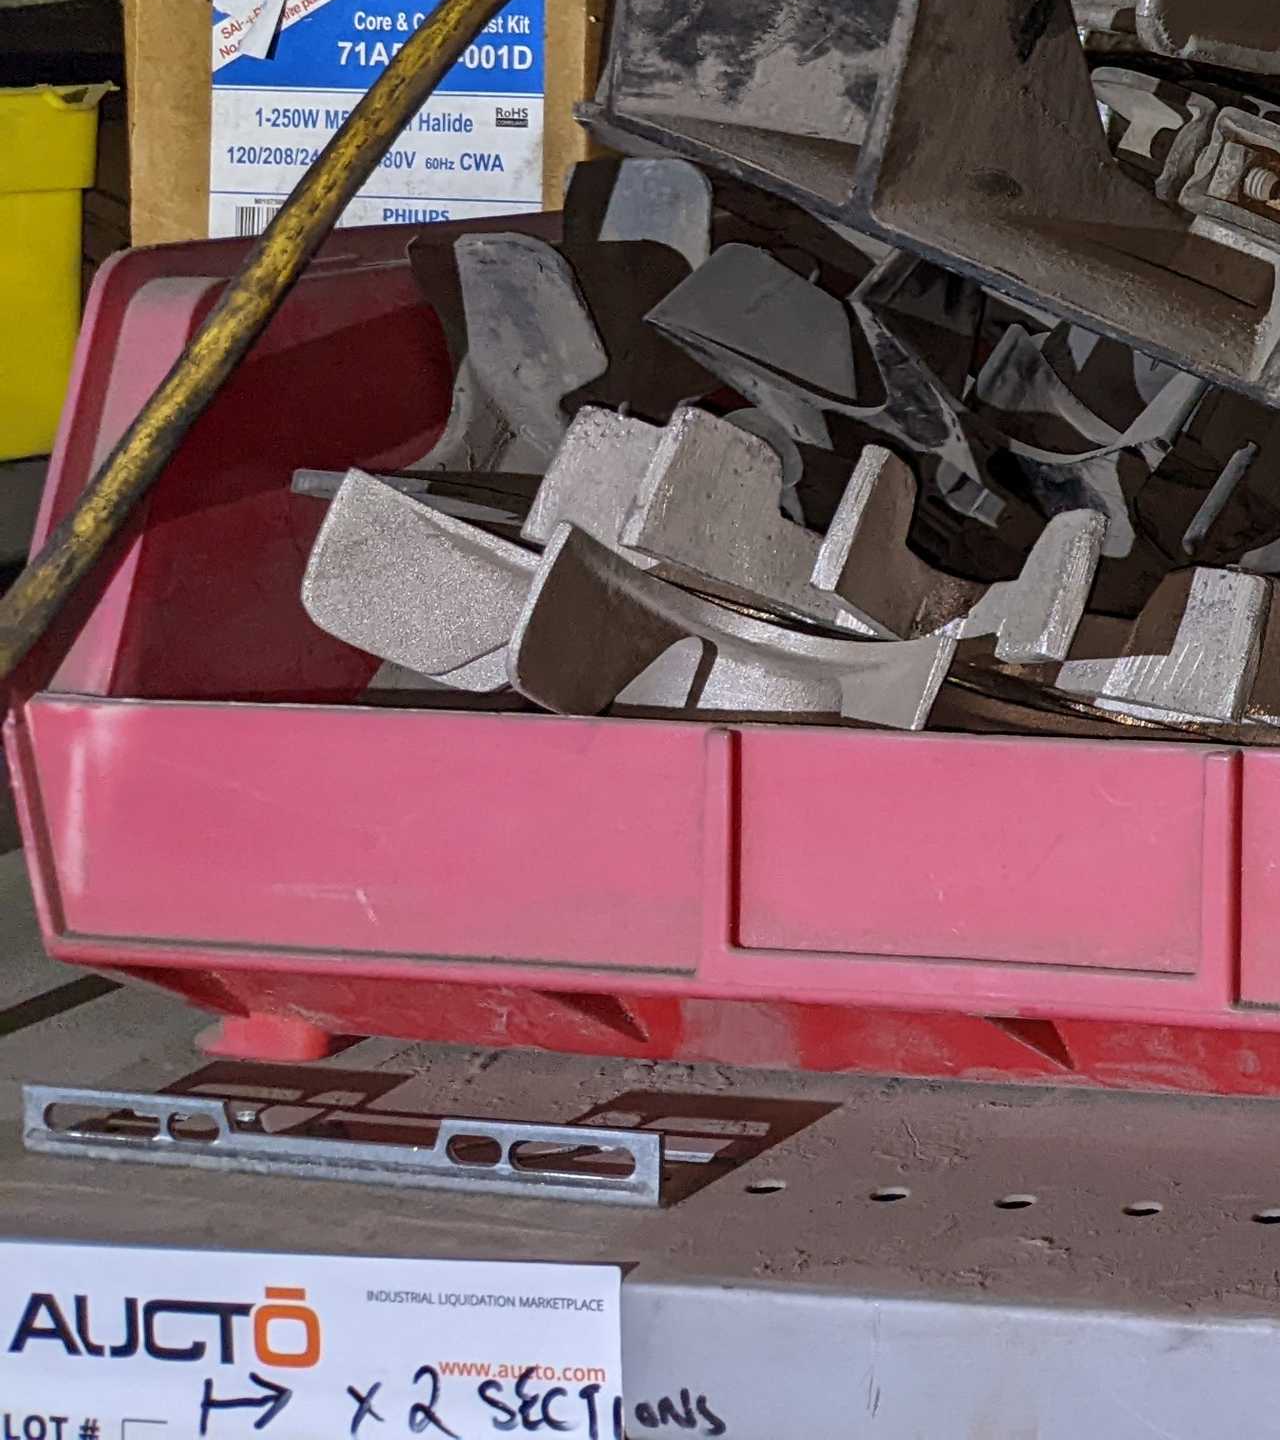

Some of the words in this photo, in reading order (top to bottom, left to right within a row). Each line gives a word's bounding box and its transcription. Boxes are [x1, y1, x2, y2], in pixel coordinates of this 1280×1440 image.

[353, 11, 392, 31] Core
[396, 12, 409, 31] &
[507, 15, 531, 35] Kit
[255, 107, 321, 130] 1-250W
[418, 112, 474, 134] Halide
[495, 107, 529, 119] RoHS
[425, 157, 455, 171] 60Hz
[460, 152, 505, 173] CWA
[366, 1290, 435, 1305] INDUSTRIAL
[438, 1292, 516, 1308] LIQUIDATION
[518, 1296, 605, 1312] MARKETPLACE
[438, 1360, 606, 1384] www.aucto.com
[408, 1364, 461, 1440] 2
[3, 1413, 69, 1440] LOT
[79, 1417, 100, 1440] #
